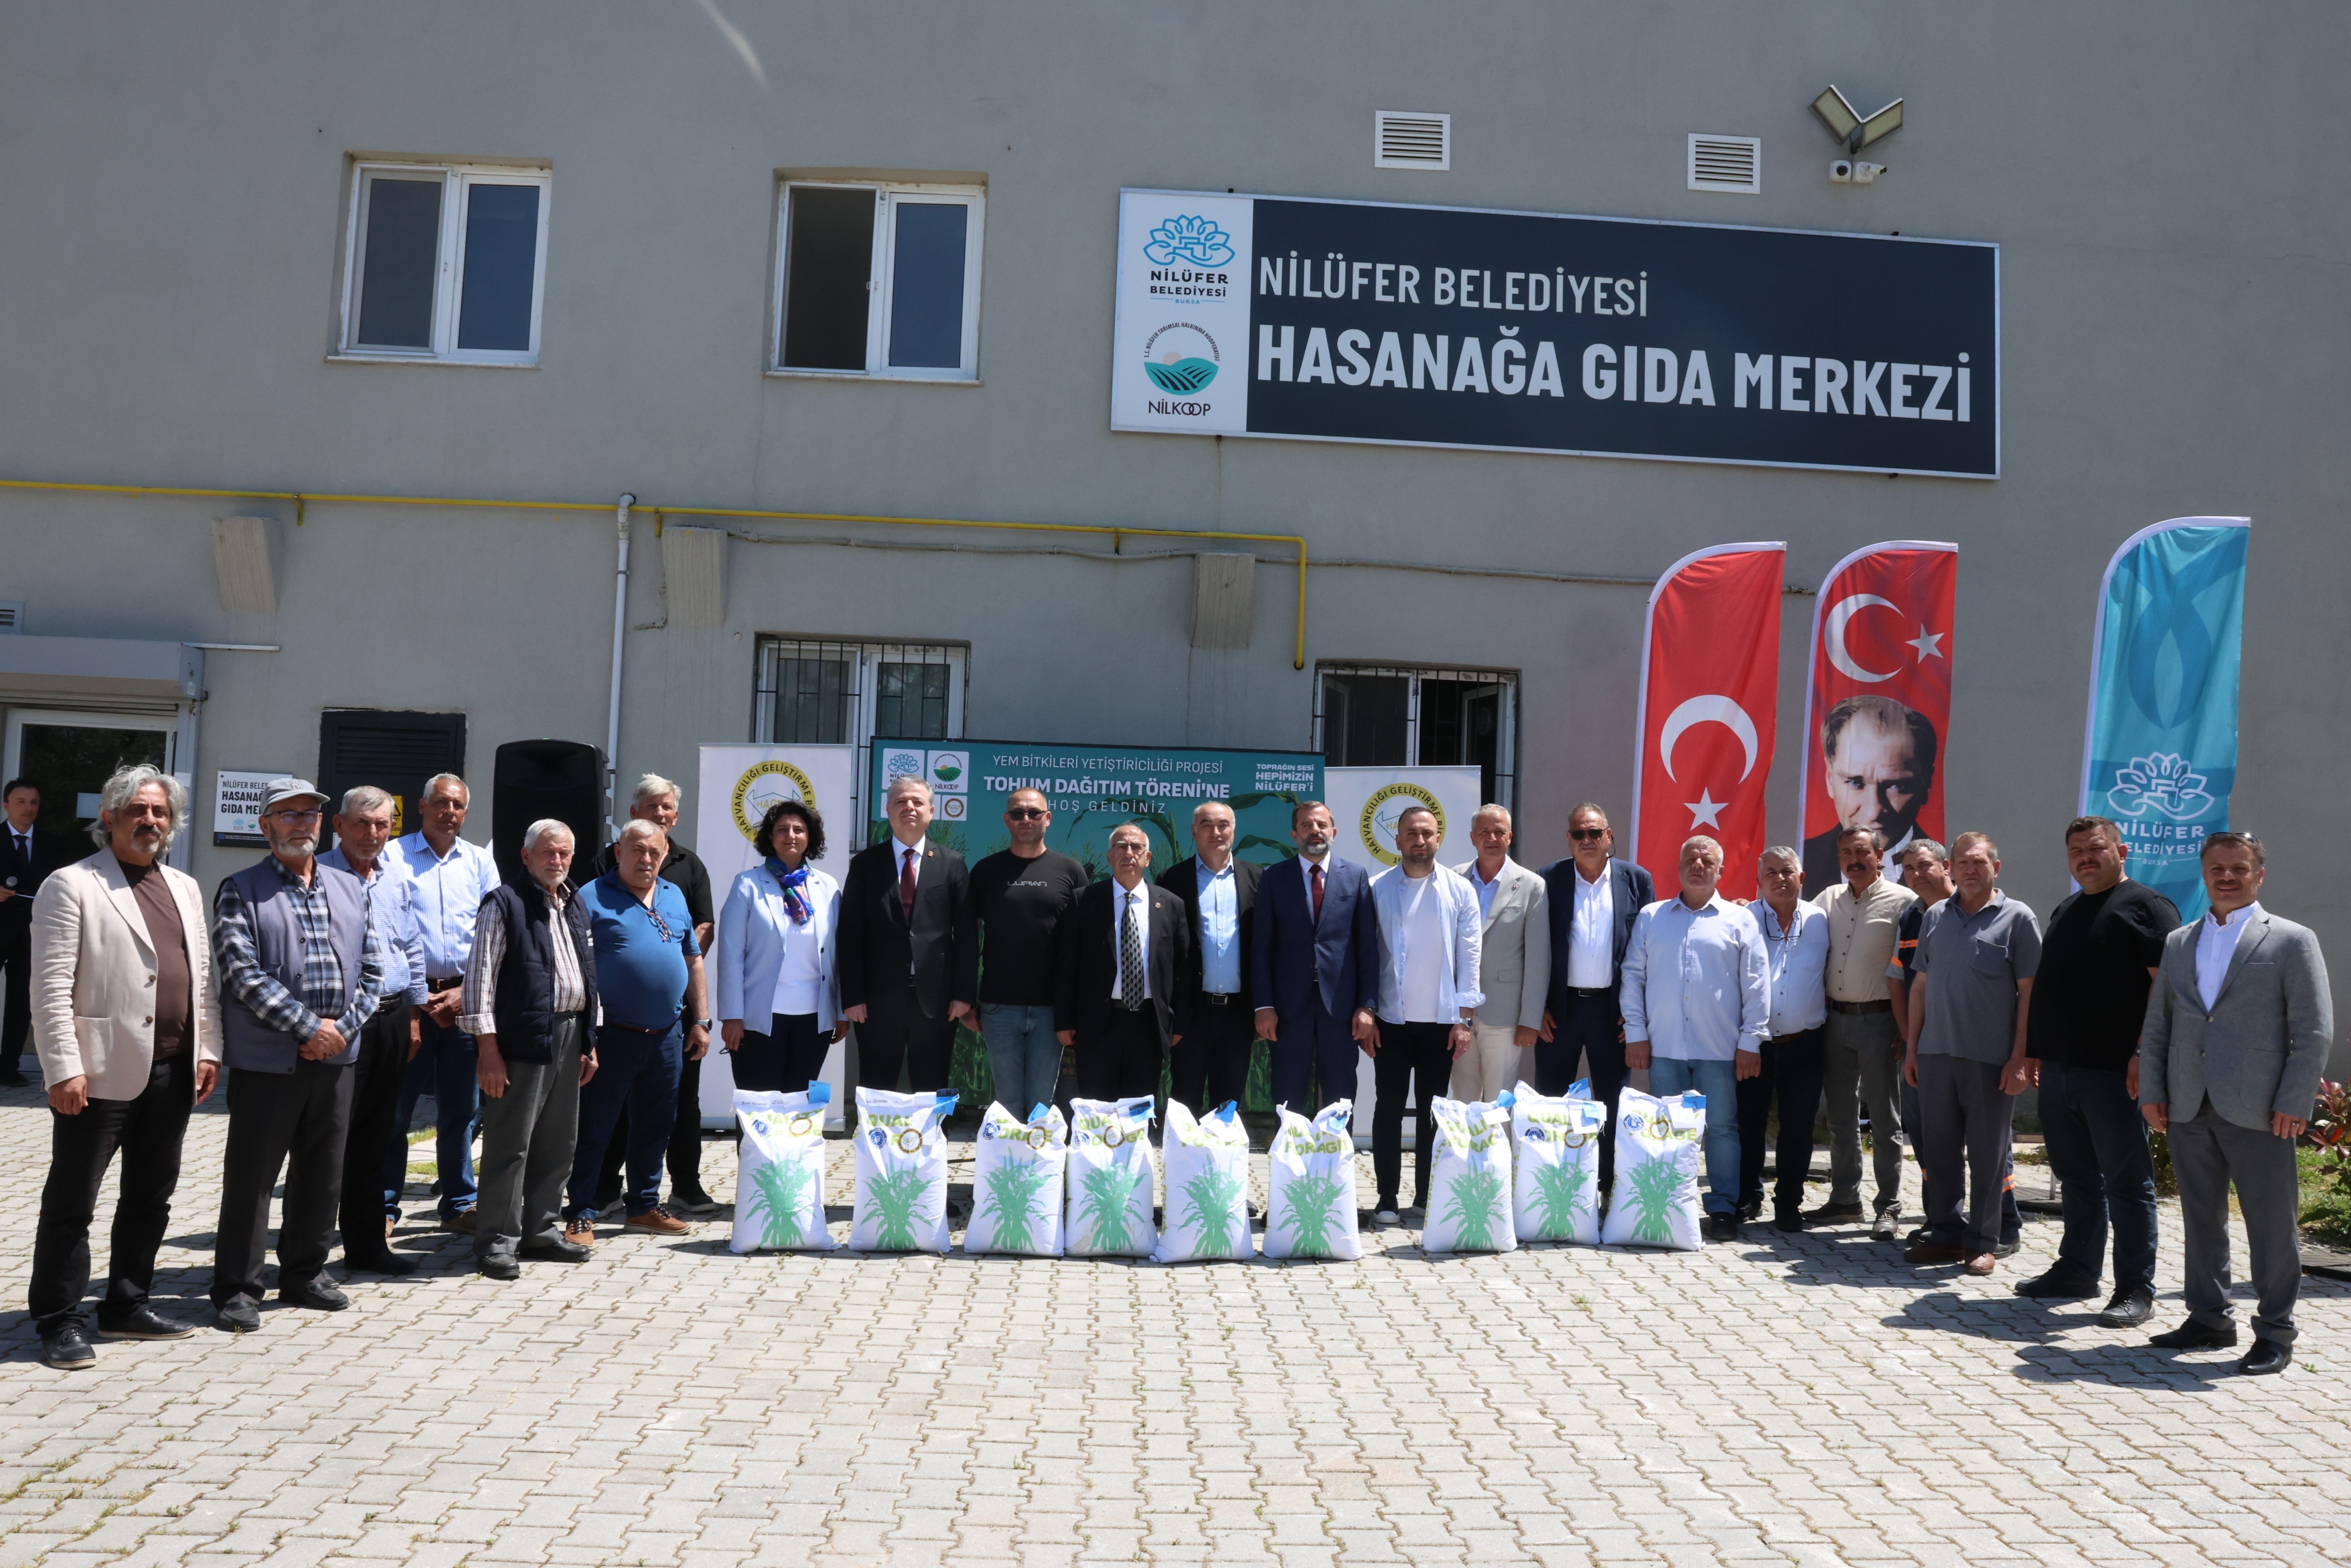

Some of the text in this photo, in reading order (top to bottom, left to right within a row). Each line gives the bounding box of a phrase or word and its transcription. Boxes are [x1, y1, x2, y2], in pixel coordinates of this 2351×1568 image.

[1151, 268, 1228, 284] NİLÜFER
[1259, 250, 1647, 317] NİLÜFER BELEDİYESİ
[1150, 285, 1226, 297] BELEDİYESİ
[1146, 332, 1160, 350] NİLÜFER
[1157, 322, 1180, 334] TARIMSAL
[1181, 322, 1206, 335] KALKINMA
[1258, 324, 1970, 422] HASANAĞA GIDA MERKEZİ
[1148, 398, 1211, 416] NİLKOOP
[993, 754, 1223, 774] YEM BİTKİLERİ YETİŞTİRİCİLİĞİ PROJESİ
[222, 780, 248, 788] NİLÜFER
[984, 775, 1230, 798] TOHUM DAĞITIM TÖRENİ'NE
[734, 768, 759, 833] HAYVANCILIĞI
[762, 763, 811, 796] GELİŞTİRME
[1049, 799, 1166, 813] HOŞ GELDİNİZ
[221, 804, 261, 815] GIDA ME
[1363, 791, 1388, 854] HAYVANCILIĞI
[2115, 819, 2205, 839] NİLÜFER
[2124, 841, 2201, 855] ELEDİYESİ
[2143, 858, 2168, 866] BURSA
